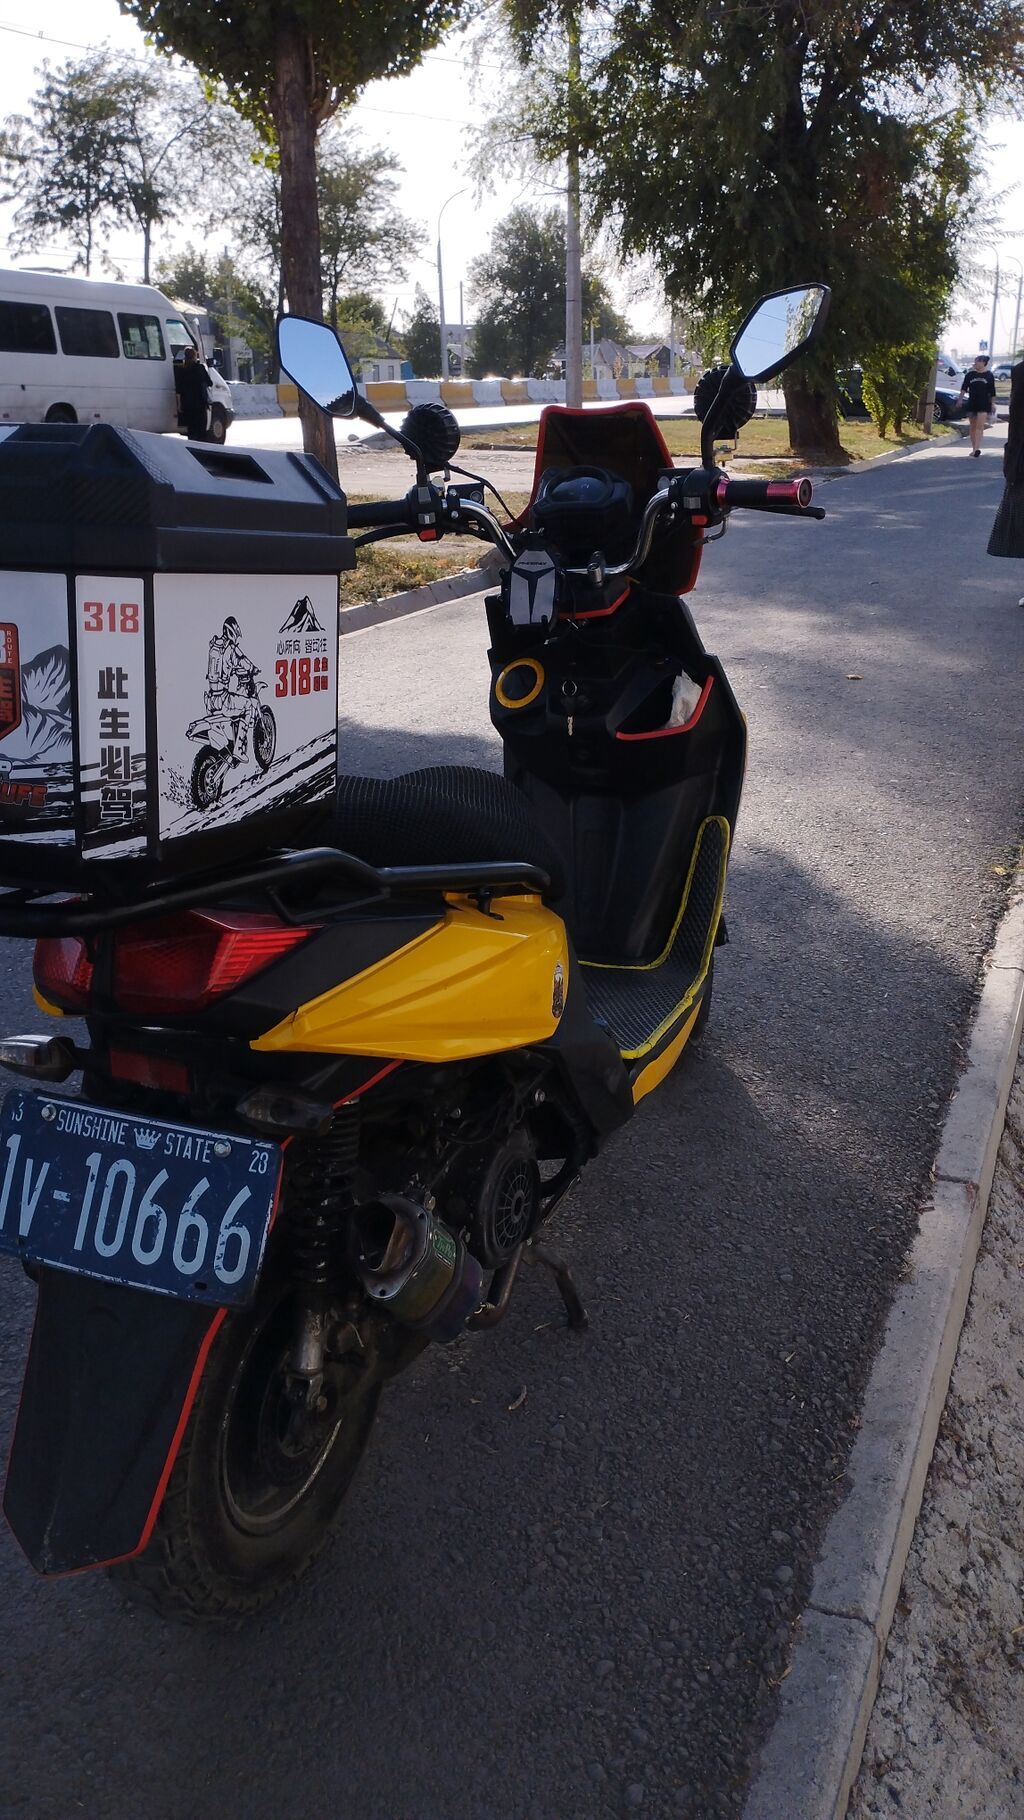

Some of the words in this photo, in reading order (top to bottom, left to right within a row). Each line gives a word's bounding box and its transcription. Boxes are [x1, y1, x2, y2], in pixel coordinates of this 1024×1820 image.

[83, 601, 140, 633] 318
[276, 639, 301, 655] 心所向
[275, 657, 311, 698] 318
[97, 667, 133, 820] 此生必驾
[56, 1109, 129, 1146] SUNSHINE
[163, 1132, 216, 1164] STATE
